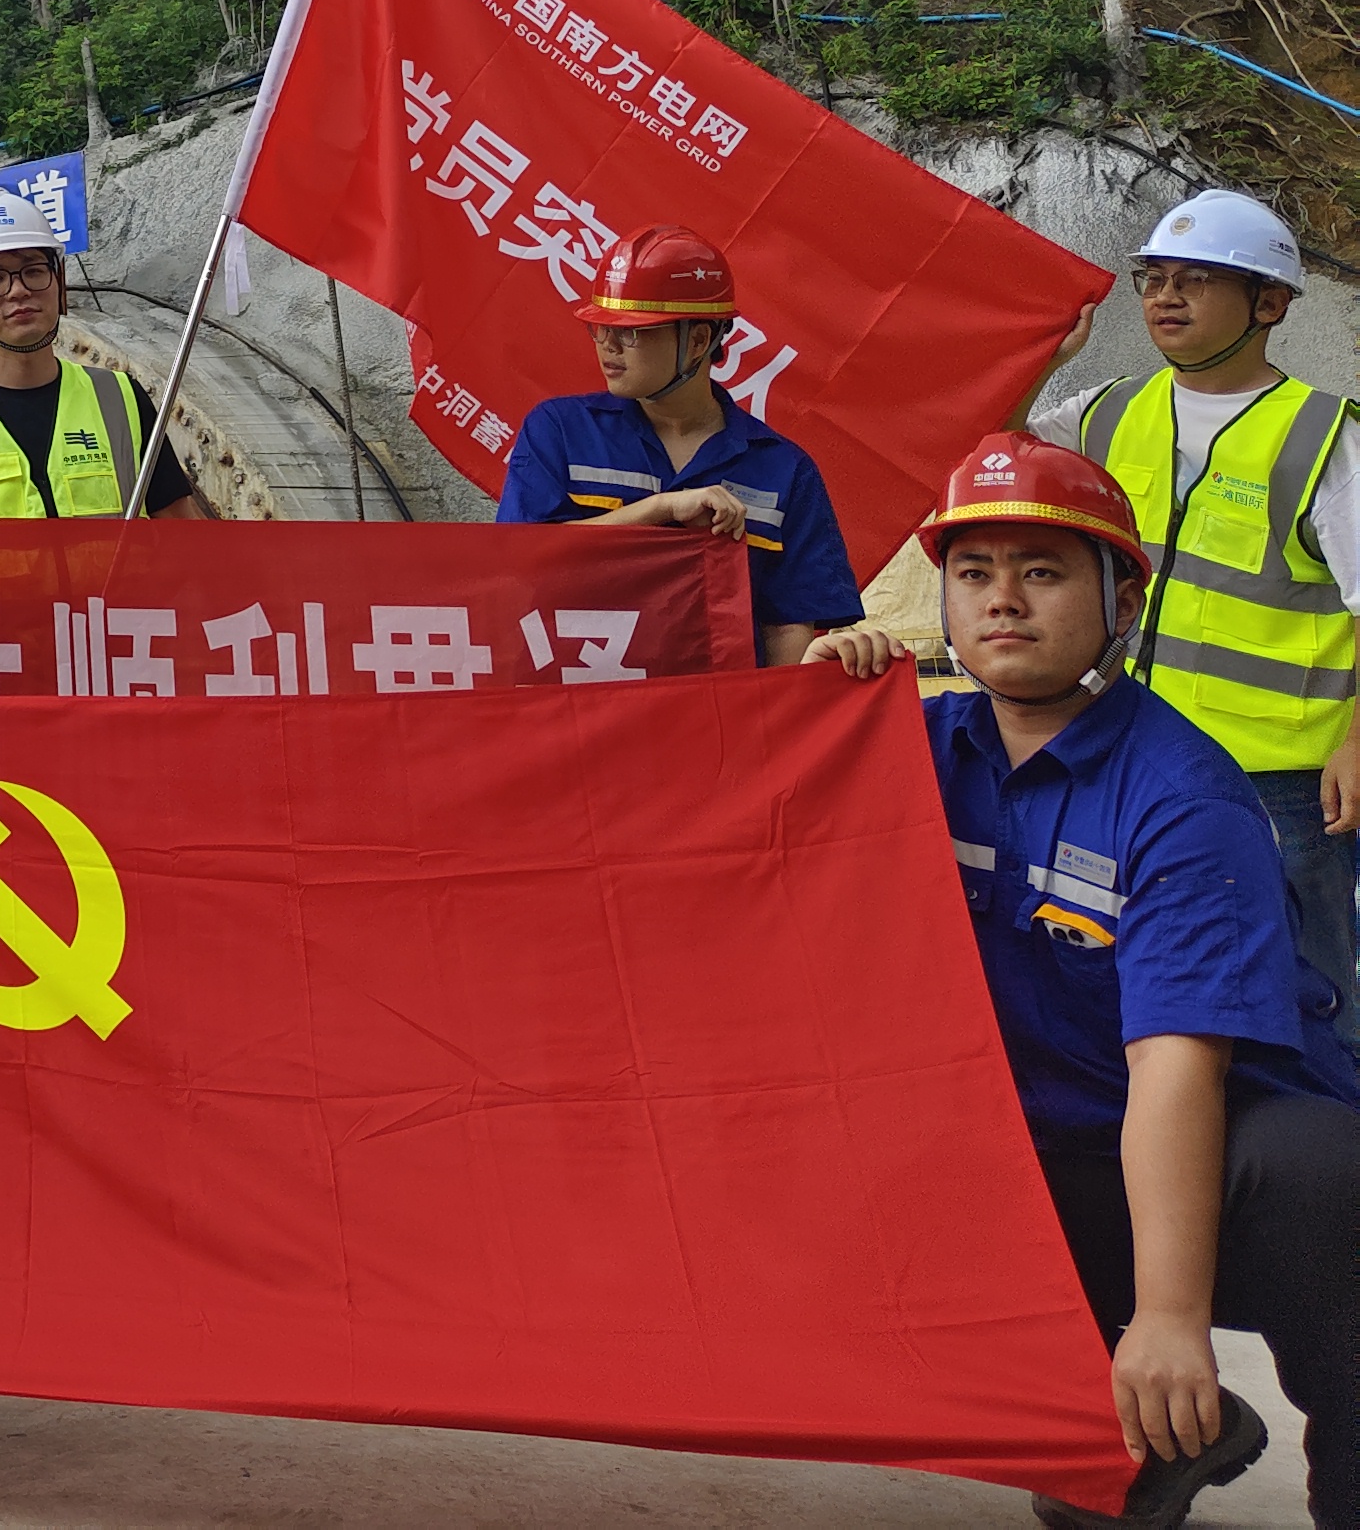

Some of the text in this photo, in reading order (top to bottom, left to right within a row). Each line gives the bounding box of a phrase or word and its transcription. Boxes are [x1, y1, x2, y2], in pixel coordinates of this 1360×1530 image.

[514, 23, 607, 95] SOUTHERN
[607, 90, 674, 142] POWER
[675, 137, 722, 173] GRID
[401, 58, 800, 427] 党员突队
[417, 363, 515, 465] 中洞蓄
